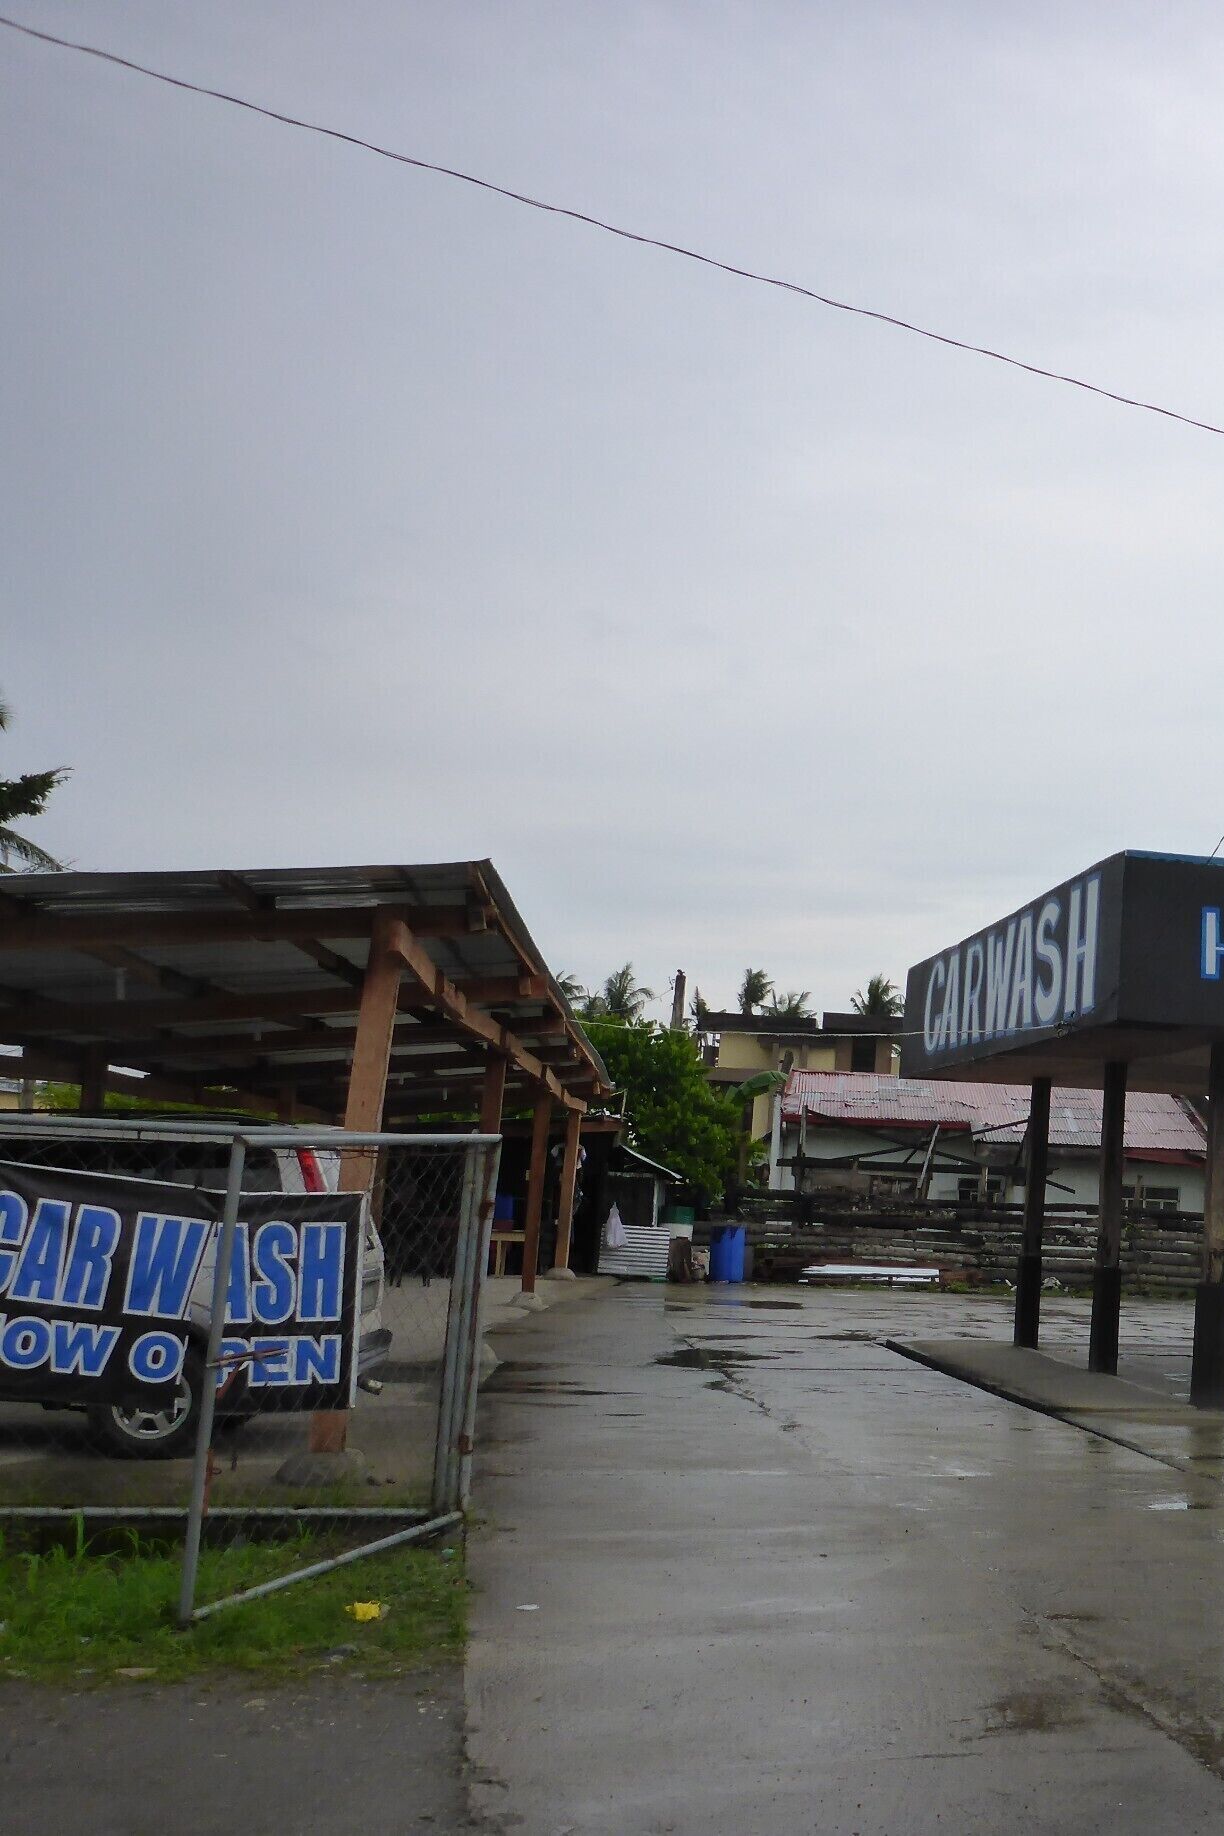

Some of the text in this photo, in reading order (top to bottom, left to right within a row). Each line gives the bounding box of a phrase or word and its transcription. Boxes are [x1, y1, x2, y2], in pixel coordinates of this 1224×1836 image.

[924, 870, 1101, 1056] CARWASH
[122, 1212, 347, 1325] WASH
[0, 1313, 123, 1378] OW
